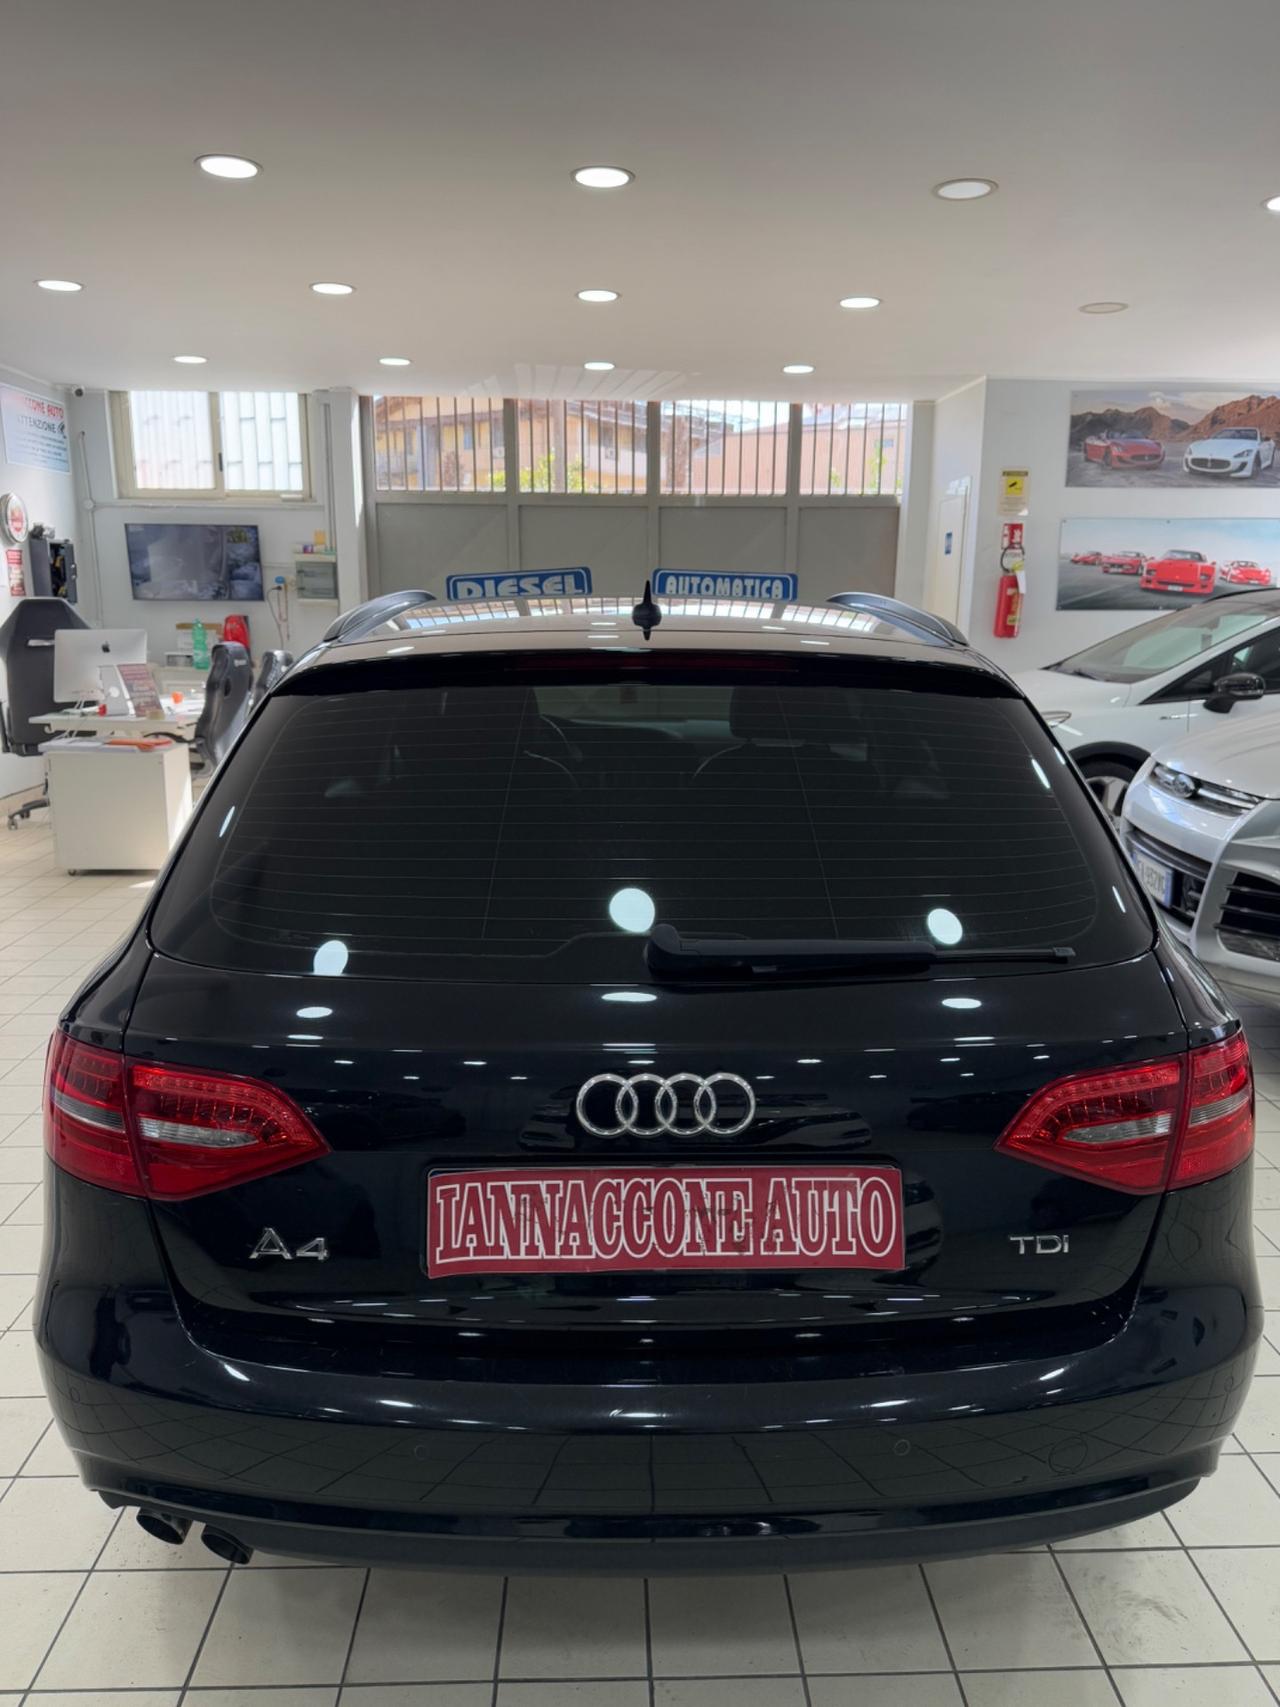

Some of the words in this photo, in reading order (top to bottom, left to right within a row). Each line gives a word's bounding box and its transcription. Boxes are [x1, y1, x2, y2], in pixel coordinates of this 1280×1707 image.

[456, 574, 583, 598] DIESEL
[665, 575, 784, 599] AUTOMATICA
[435, 1177, 753, 1264] IANNACCONE
[760, 1175, 897, 1258] AUTO
[248, 1227, 328, 1260] A4
